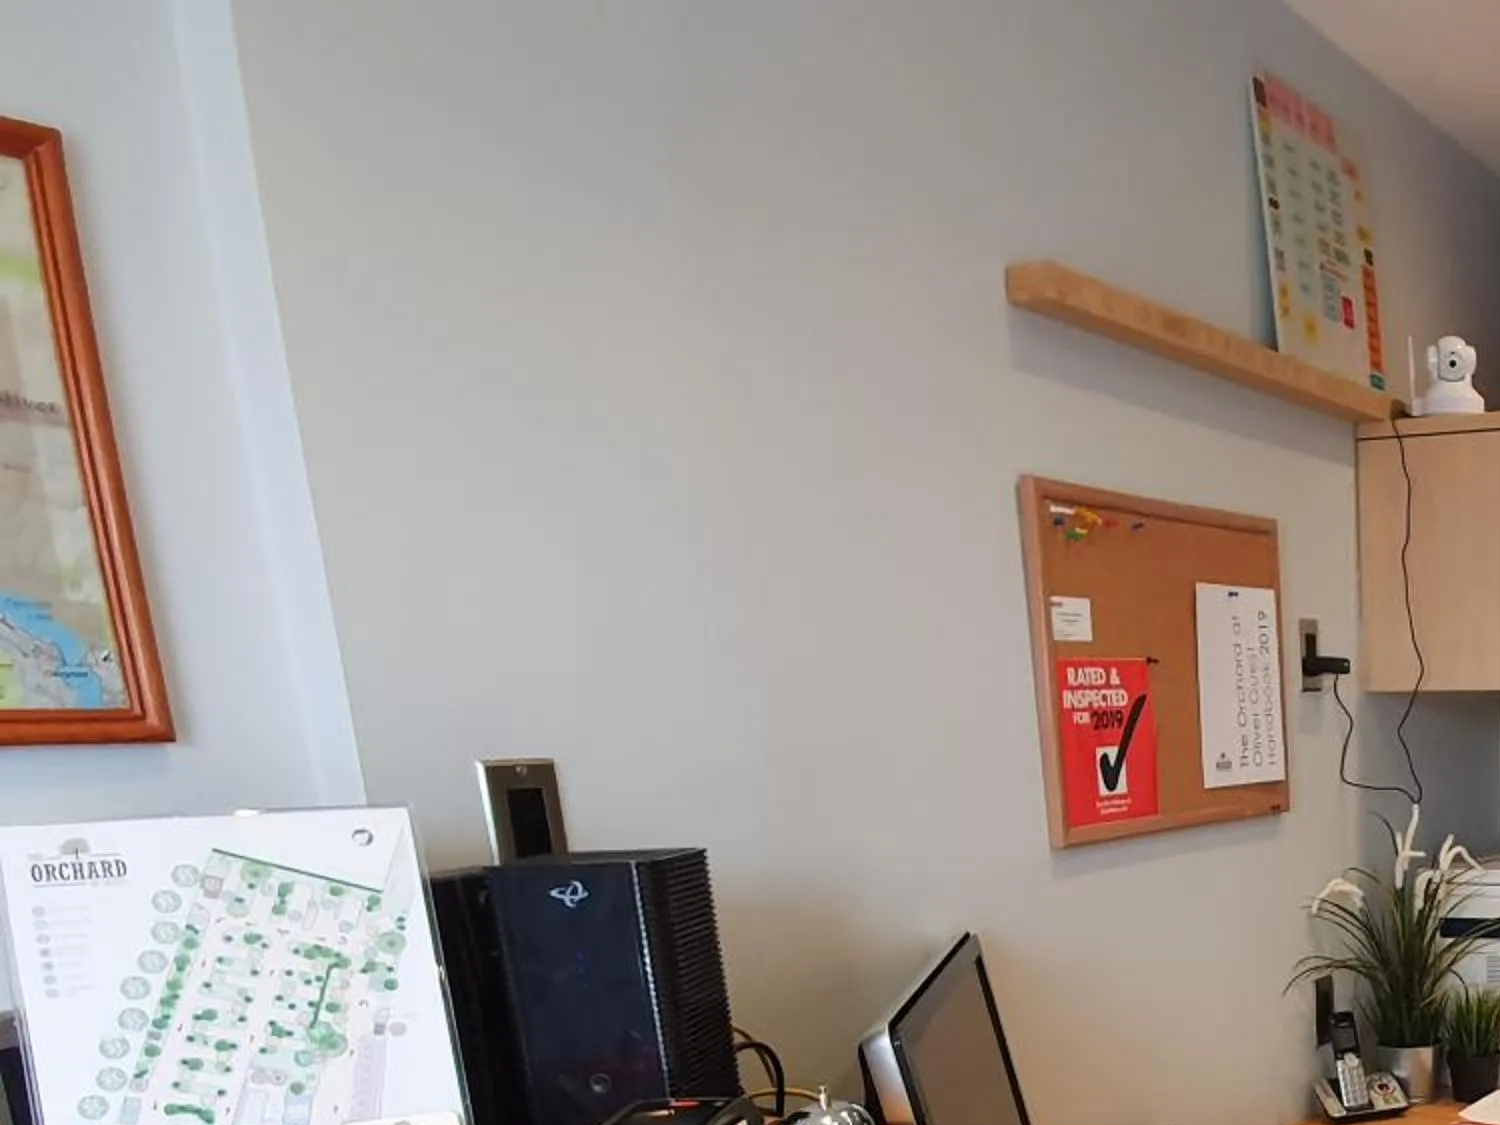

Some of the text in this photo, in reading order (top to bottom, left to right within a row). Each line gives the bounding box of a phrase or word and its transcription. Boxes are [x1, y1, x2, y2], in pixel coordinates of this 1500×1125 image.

[1258, 611, 1270, 655] 2019
[1066, 667, 1120, 686] RATED &
[1232, 643, 1247, 728] Orchard
[1062, 689, 1128, 708] INSPECTED
[1072, 711, 1124, 730] FOR 2019
[31, 859, 127, 883] ORCHARD
